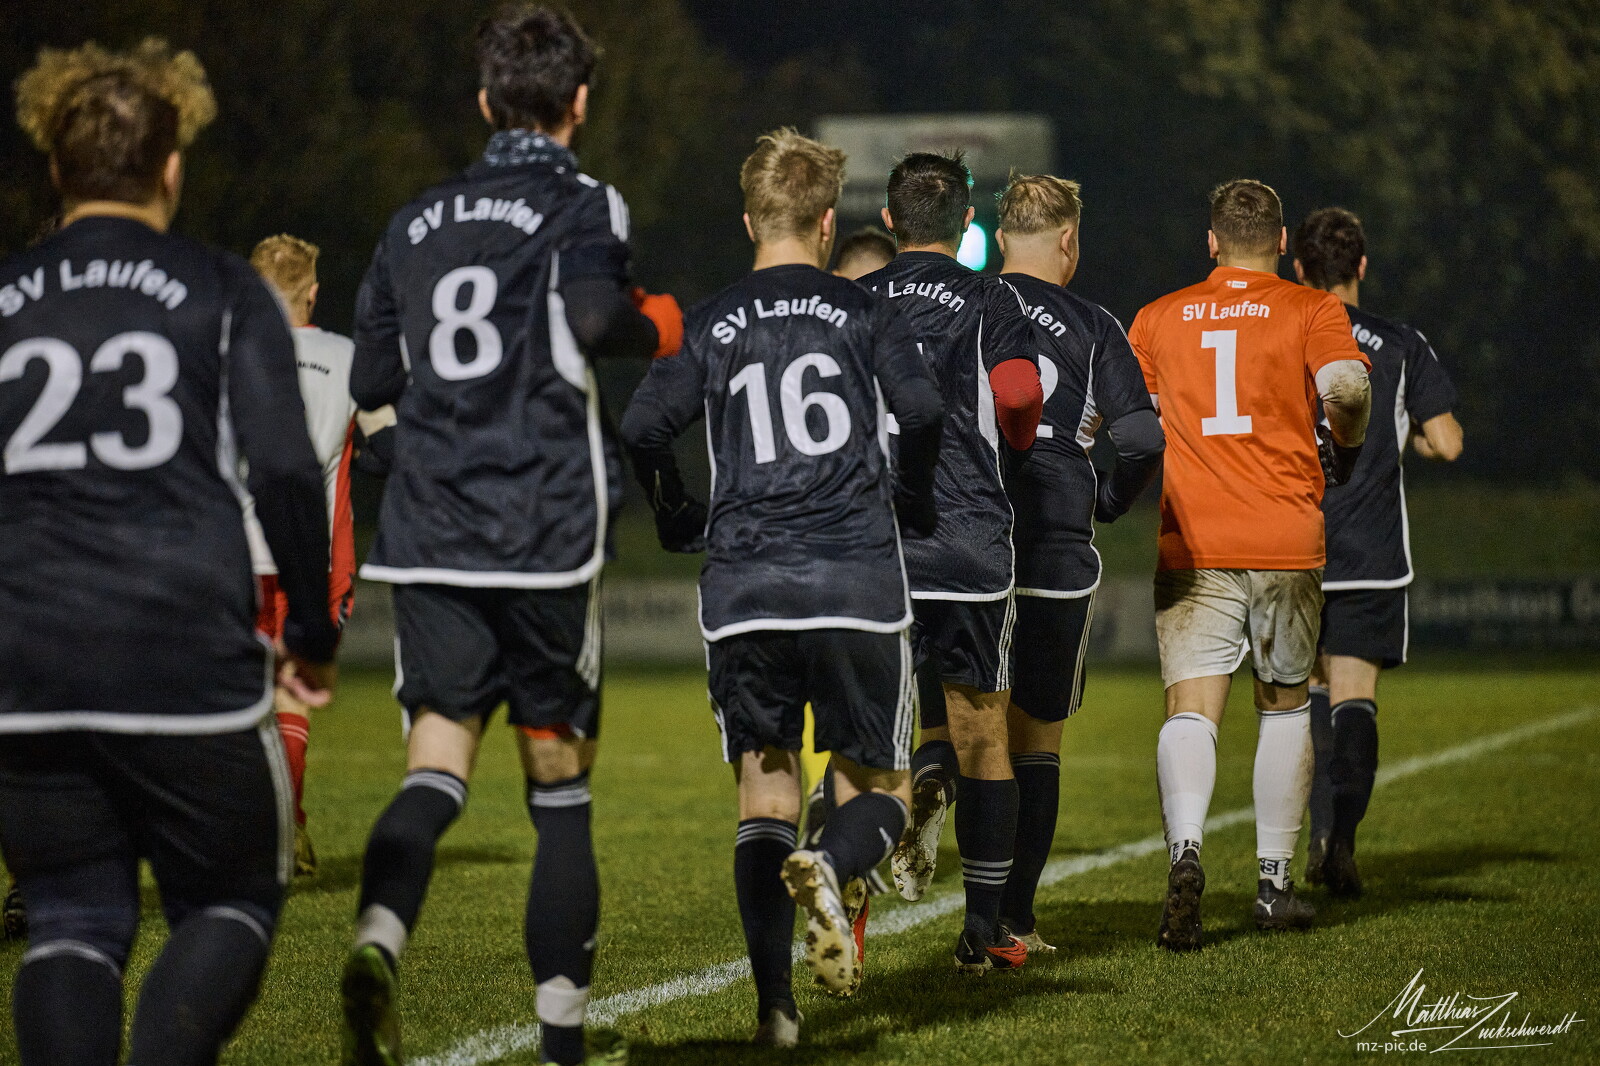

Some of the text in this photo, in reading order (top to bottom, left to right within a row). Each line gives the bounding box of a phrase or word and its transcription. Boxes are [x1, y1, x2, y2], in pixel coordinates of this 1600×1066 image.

[408, 200, 444, 245] SV
[0, 258, 188, 317] SV Laufen
[888, 281, 965, 312] Laufen
[1182, 300, 1270, 321] SV Laufen
[428, 265, 503, 381] 8
[712, 295, 848, 344] SV Laufen
[1027, 305, 1066, 337] fen
[0, 331, 184, 474] 23
[728, 352, 851, 464] 16
[1200, 329, 1252, 436] 1
